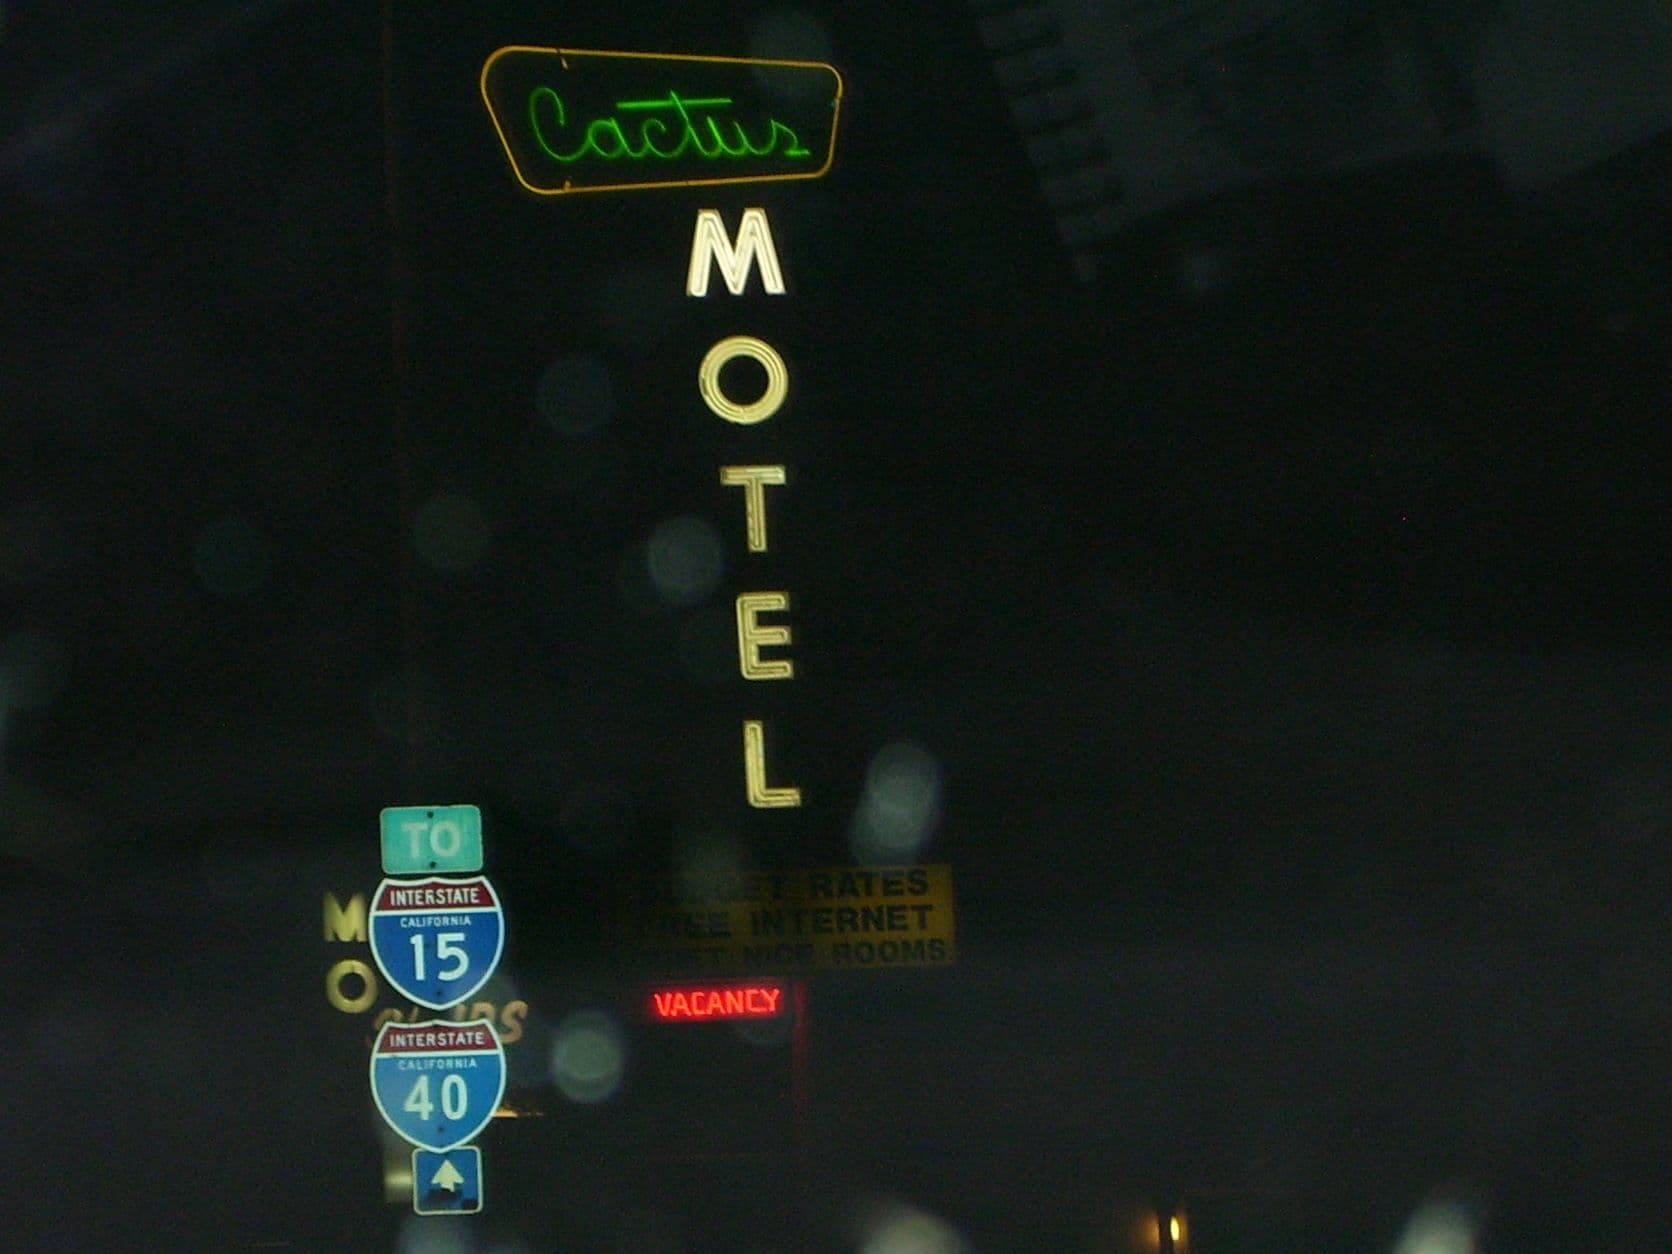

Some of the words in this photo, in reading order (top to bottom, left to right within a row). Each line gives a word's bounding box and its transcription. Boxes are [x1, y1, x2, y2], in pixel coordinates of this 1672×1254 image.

[529, 87, 811, 161] Cactus
[686, 207, 802, 809] MOTEL
[401, 820, 461, 859] TO
[389, 887, 480, 907] INTERSTATE
[808, 868, 930, 898] RATES
[400, 915, 472, 929] CALIFORNIA
[750, 903, 933, 936] INTERNET
[409, 932, 470, 982] 15
[831, 938, 946, 964] ROOMS
[652, 987, 782, 1018] VACANCY
[389, 1031, 485, 1048] INTERSTATE
[398, 1057, 478, 1071] CALIFORNIA
[403, 1073, 468, 1121] 40
